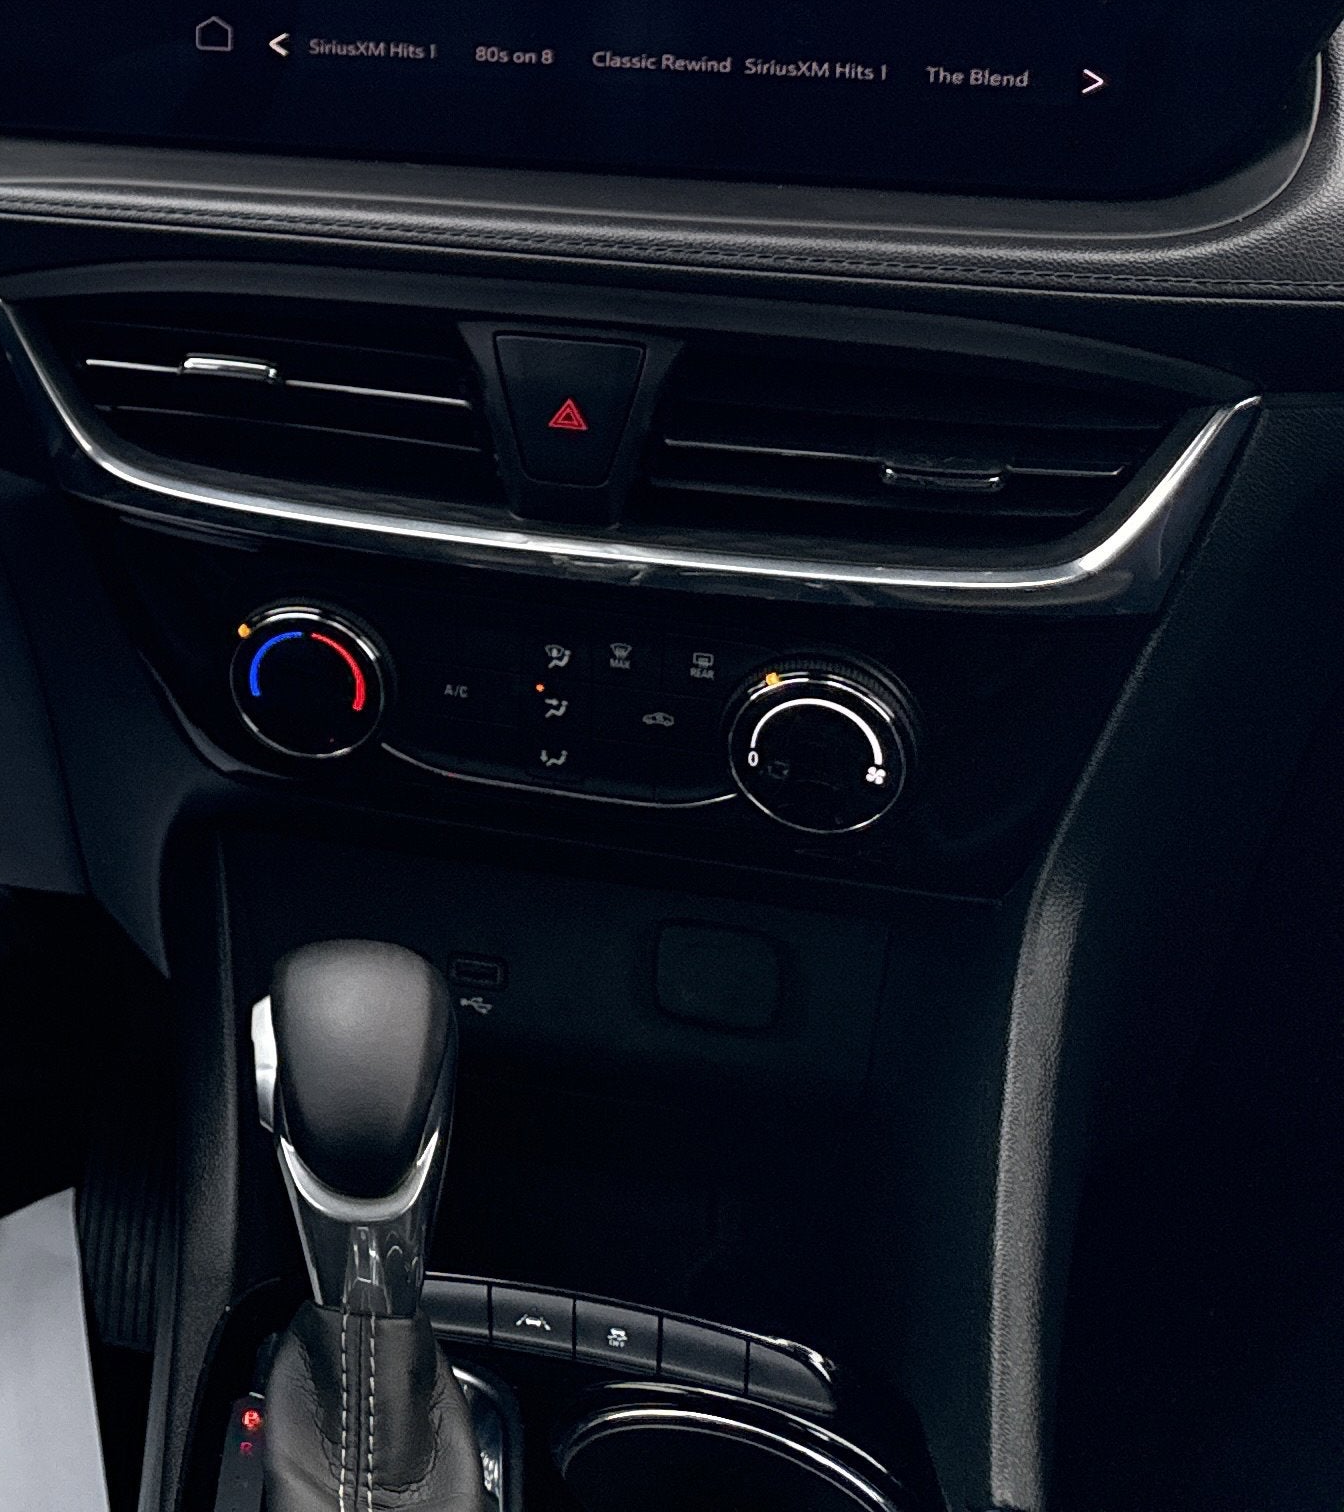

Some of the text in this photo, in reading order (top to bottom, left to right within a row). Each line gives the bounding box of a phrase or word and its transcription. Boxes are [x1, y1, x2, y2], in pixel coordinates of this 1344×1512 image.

[309, 38, 385, 57] SiriusXM
[389, 42, 426, 59] Hits
[475, 46, 554, 65] 80s on 8
[591, 51, 732, 74] Classic Rewind
[744, 58, 830, 78] SiriusXM
[835, 62, 874, 80] Hits
[926, 66, 1030, 88] The Blend
[610, 658, 631, 670] MAX
[690, 667, 715, 681] REAR
[444, 684, 469, 699] A/C
[747, 750, 759, 768] 0
[243, 1410, 260, 1428] P
